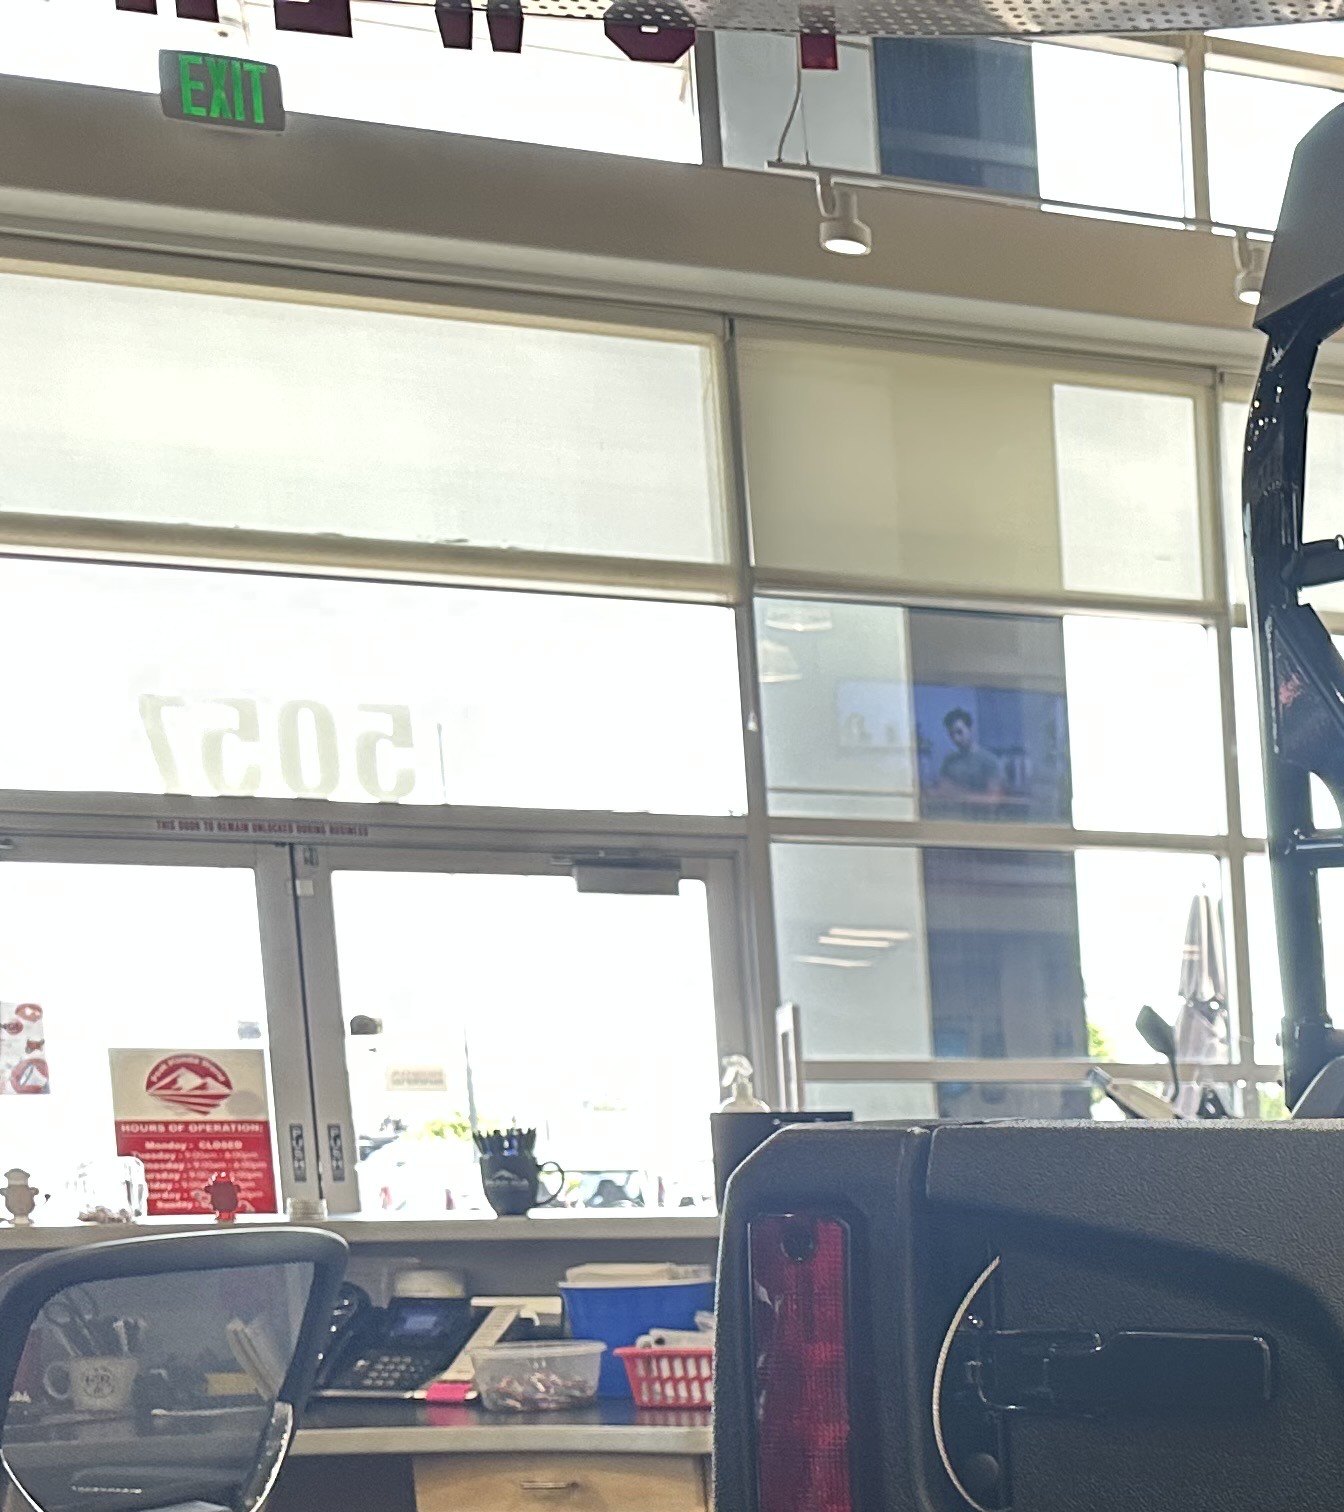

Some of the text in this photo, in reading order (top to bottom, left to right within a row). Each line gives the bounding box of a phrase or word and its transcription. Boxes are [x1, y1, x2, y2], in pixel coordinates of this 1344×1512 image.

[179, 54, 267, 124] EXIT
[121, 1123, 165, 1133] HOURS
[169, 1123, 184, 1133] OF
[145, 1141, 187, 1151] Monday
[199, 1141, 243, 1150] CLOSED
